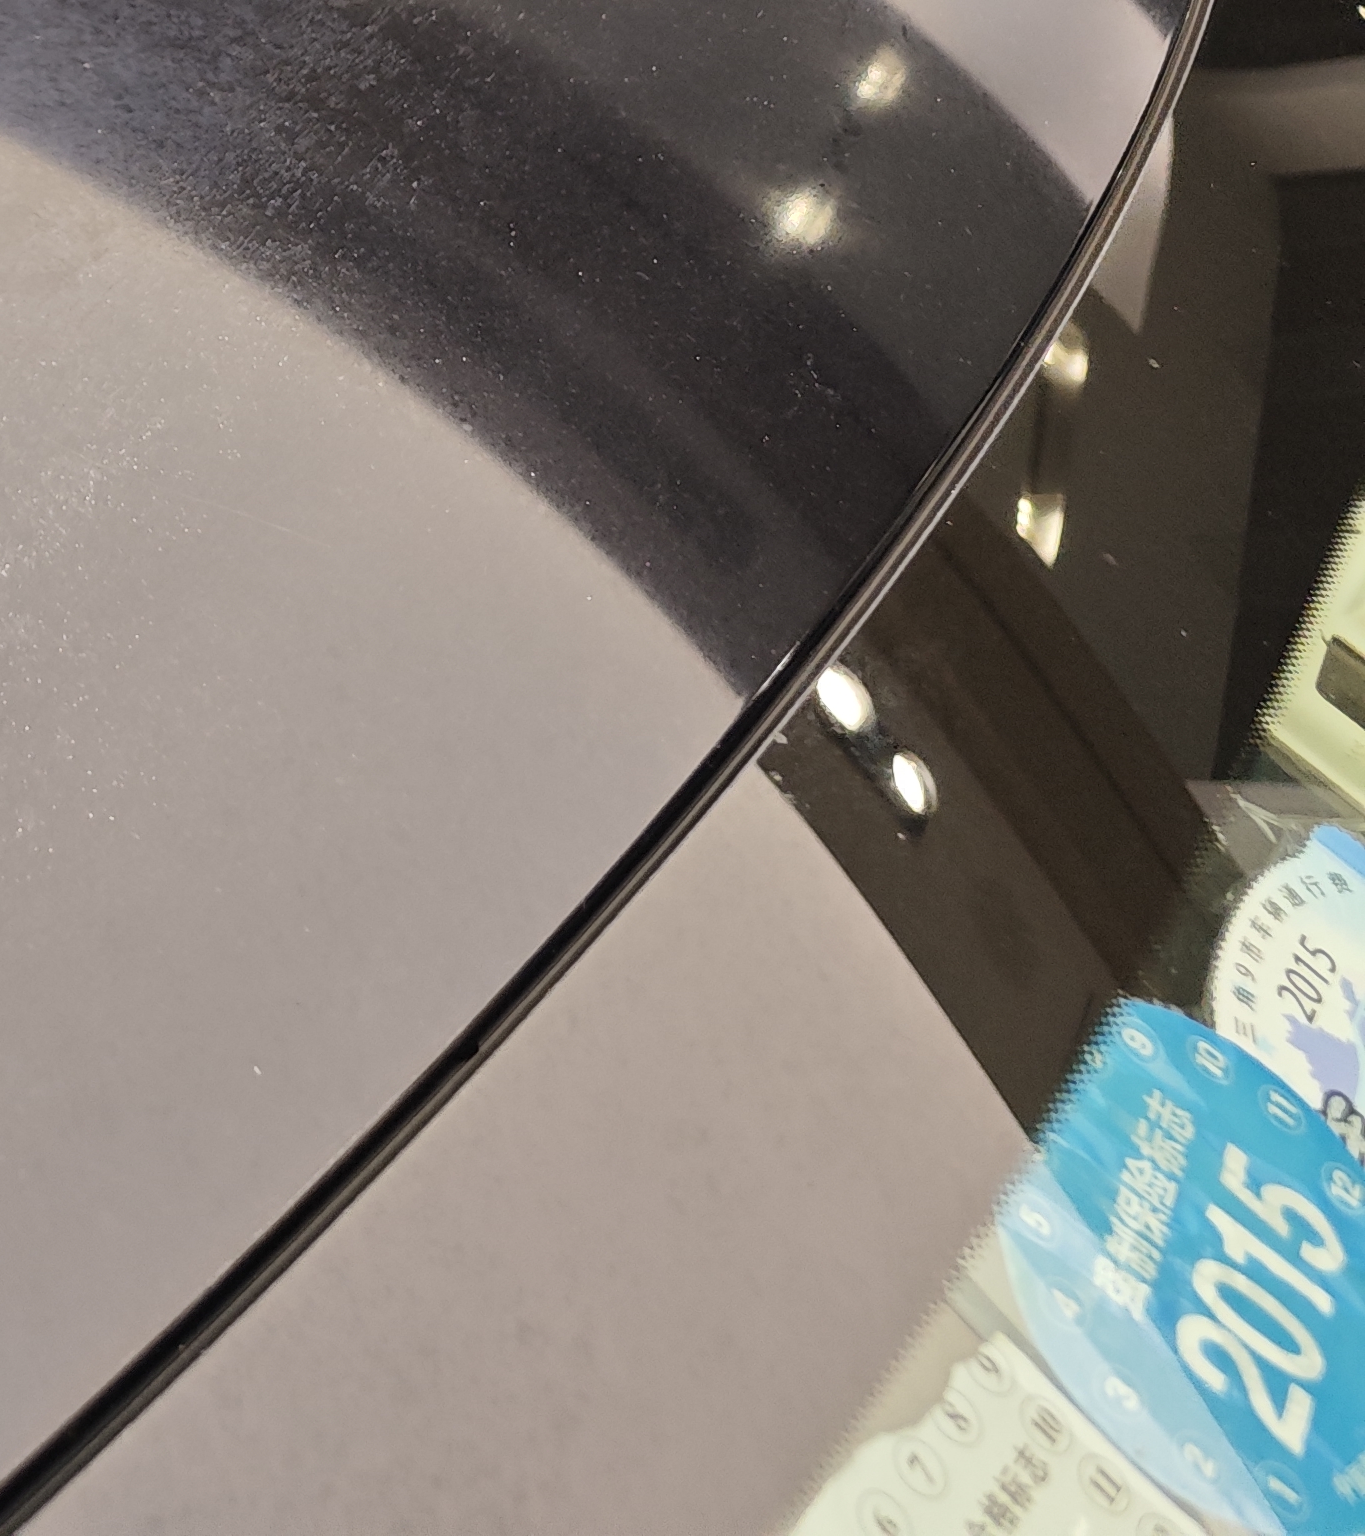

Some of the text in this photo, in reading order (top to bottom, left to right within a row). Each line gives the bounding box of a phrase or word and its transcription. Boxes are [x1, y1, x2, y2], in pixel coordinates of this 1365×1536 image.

[1277, 934, 1337, 1024] 2015
[1122, 1028, 1155, 1056] 9
[1195, 1040, 1226, 1078] 10
[1267, 1089, 1298, 1126] 11
[1093, 1088, 1195, 1321] 强制保险标志
[1331, 1169, 1363, 1208] 12
[1019, 1205, 1051, 1235] 5
[1050, 1288, 1080, 1321] 4
[1175, 1142, 1346, 1457] 2015
[1105, 1376, 1141, 1412] 3
[1031, 1406, 1062, 1445] 10
[906, 1452, 936, 1485] 7
[1184, 1443, 1217, 1478] 2
[1090, 1465, 1122, 1504] 11
[1268, 1474, 1301, 1506] 1
